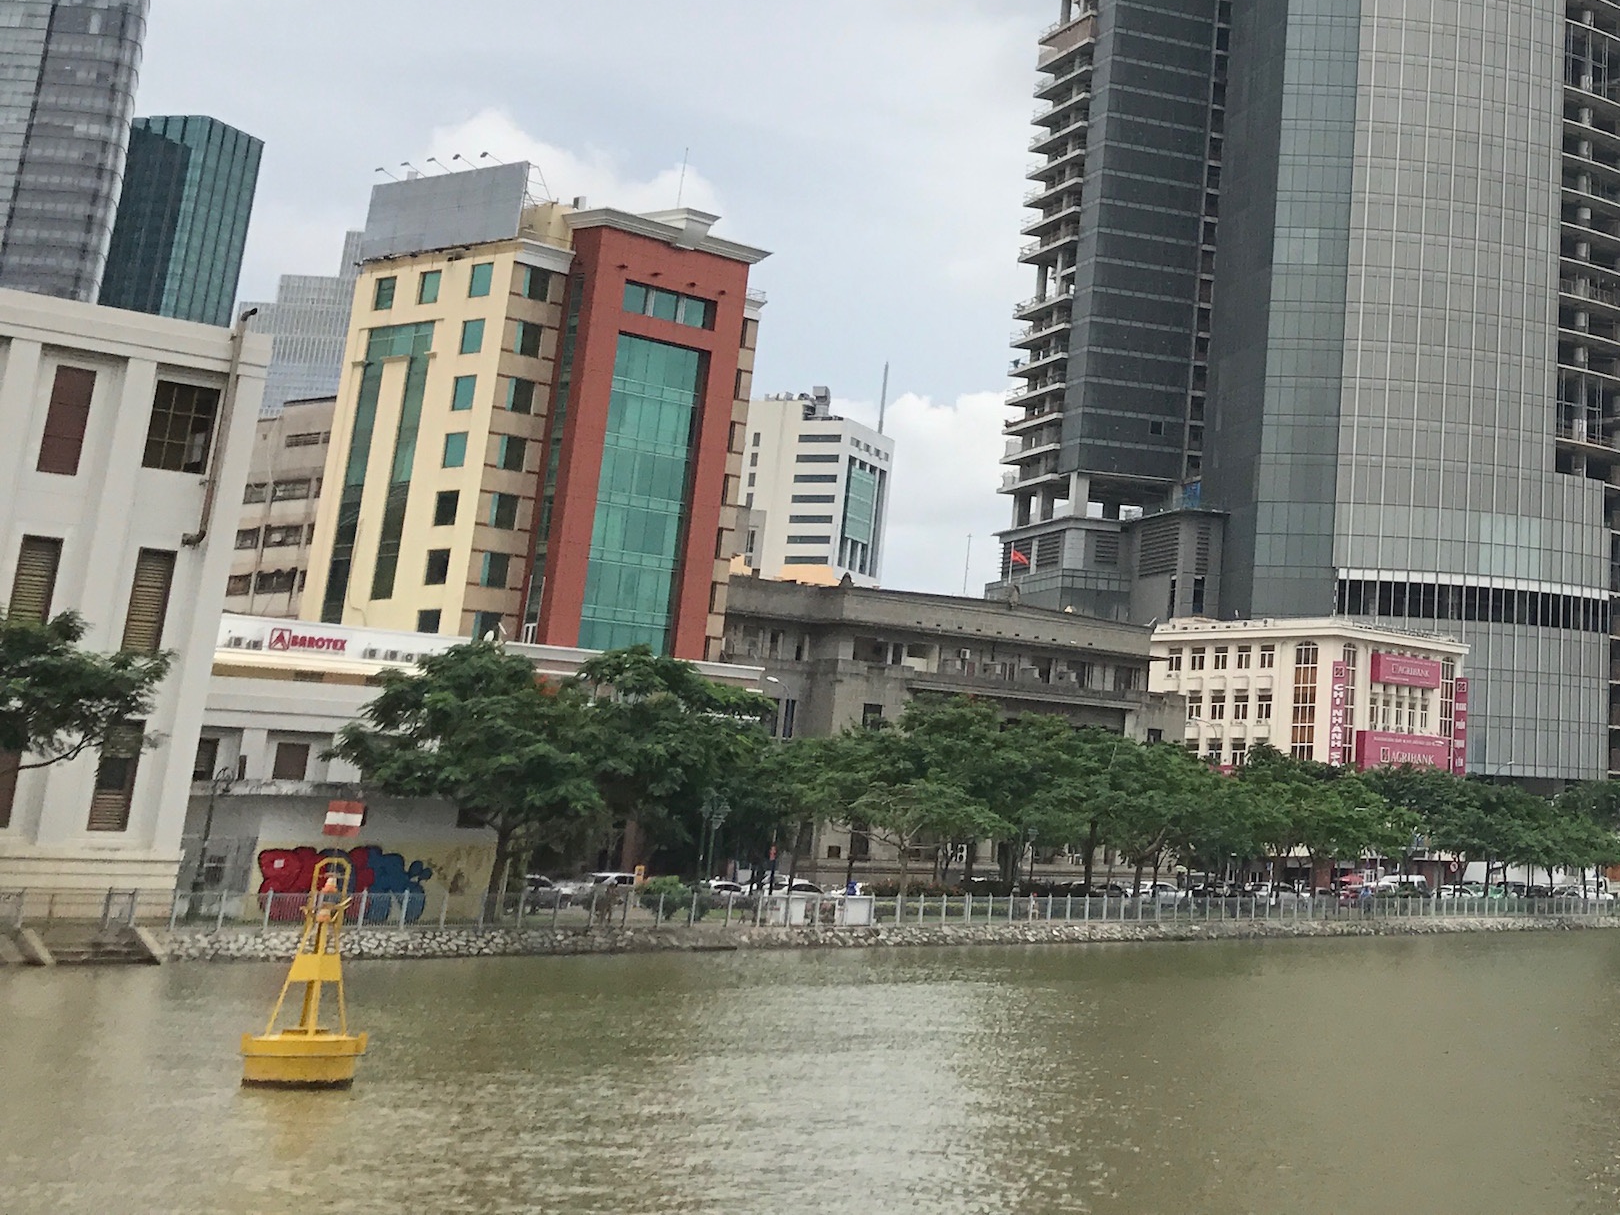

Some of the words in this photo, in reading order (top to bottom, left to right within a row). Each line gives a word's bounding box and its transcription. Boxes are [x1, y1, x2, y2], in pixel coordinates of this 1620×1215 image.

[291, 635, 347, 651] BAROTEX
[1398, 666, 1431, 677] AGRIBANK
[1333, 684, 1344, 705] CHI
[1391, 751, 1435, 764] AGRIBANK
